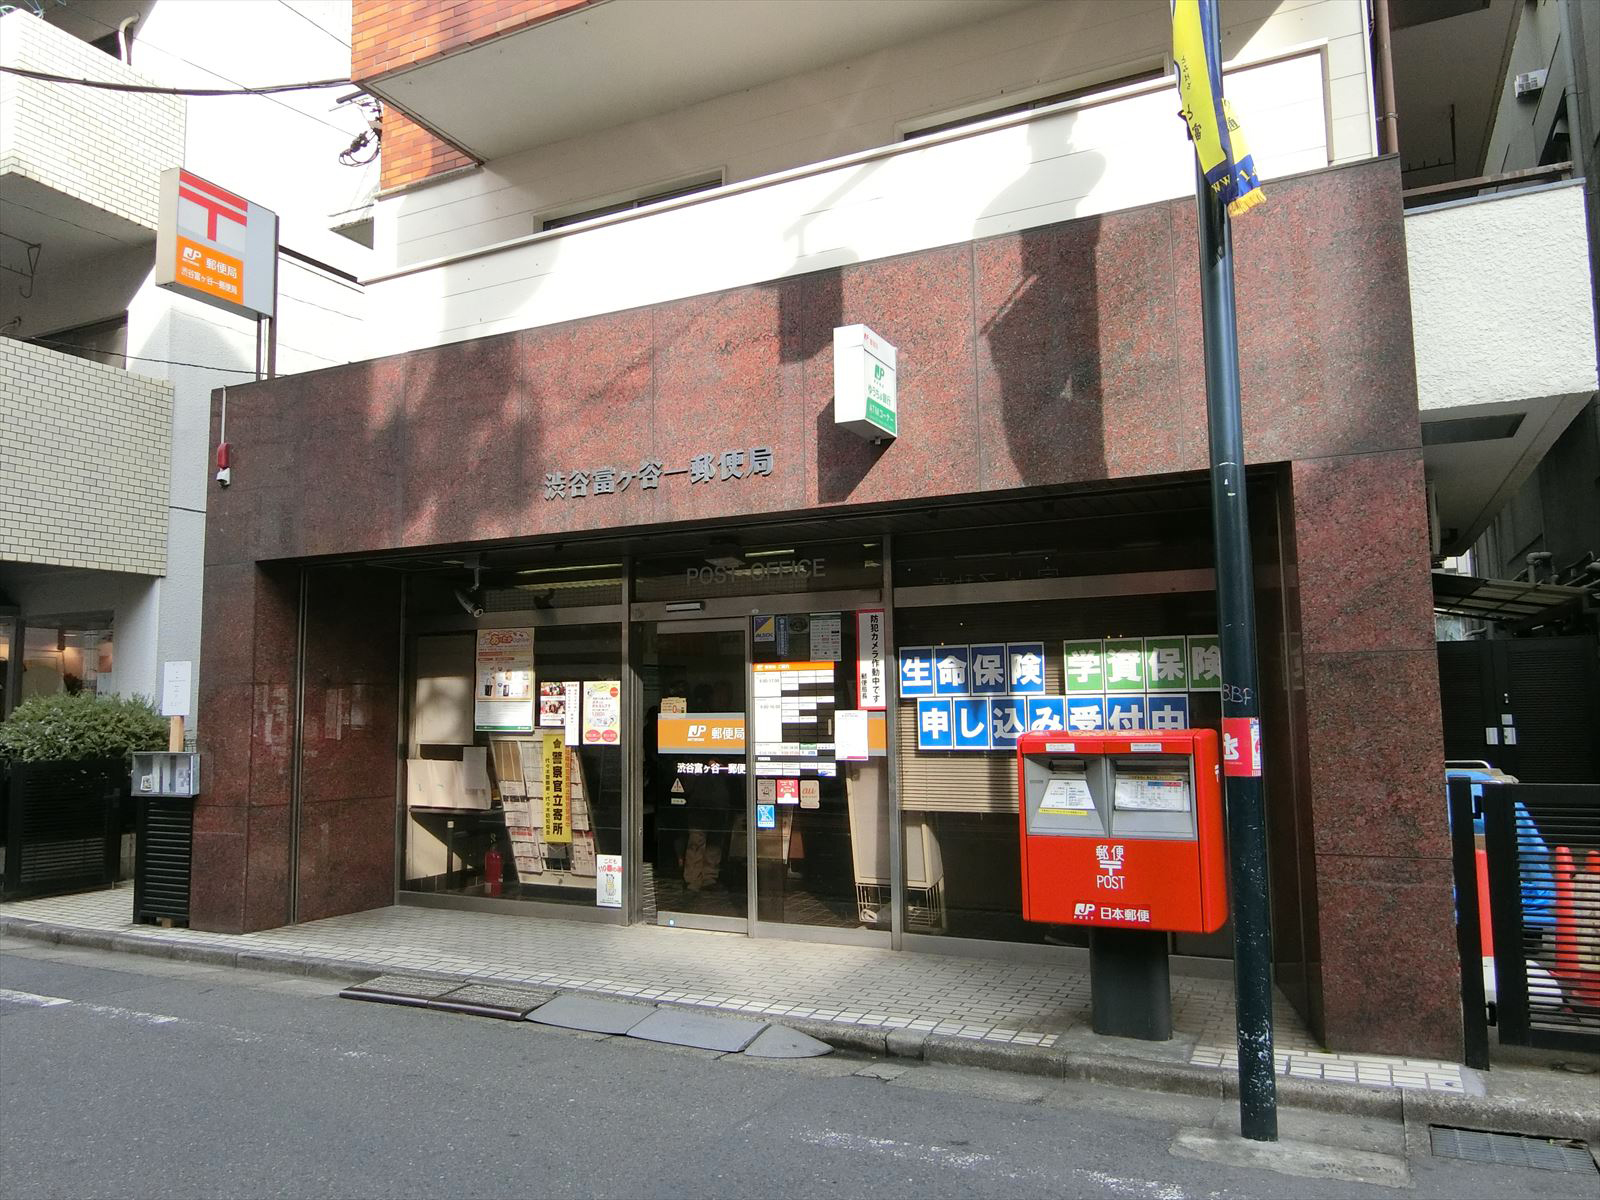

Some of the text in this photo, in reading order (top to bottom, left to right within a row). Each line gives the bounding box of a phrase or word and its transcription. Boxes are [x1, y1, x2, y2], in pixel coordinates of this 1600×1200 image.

[206, 258, 238, 279] 郵便局
[868, 384, 891, 407] ゆうちょ銀行
[686, 558, 826, 585] POST OFFICE
[870, 615, 881, 703] 防犯カメラ作動中です
[902, 653, 1042, 688] 生命保険
[1067, 646, 1221, 684] 学資保険
[711, 727, 744, 740] 郵便局
[552, 751, 563, 836] 警察官立寄所
[1096, 845, 1125, 861] 郵便
[1096, 875, 1125, 890] POST
[1100, 907, 1150, 922] 日本郵便
